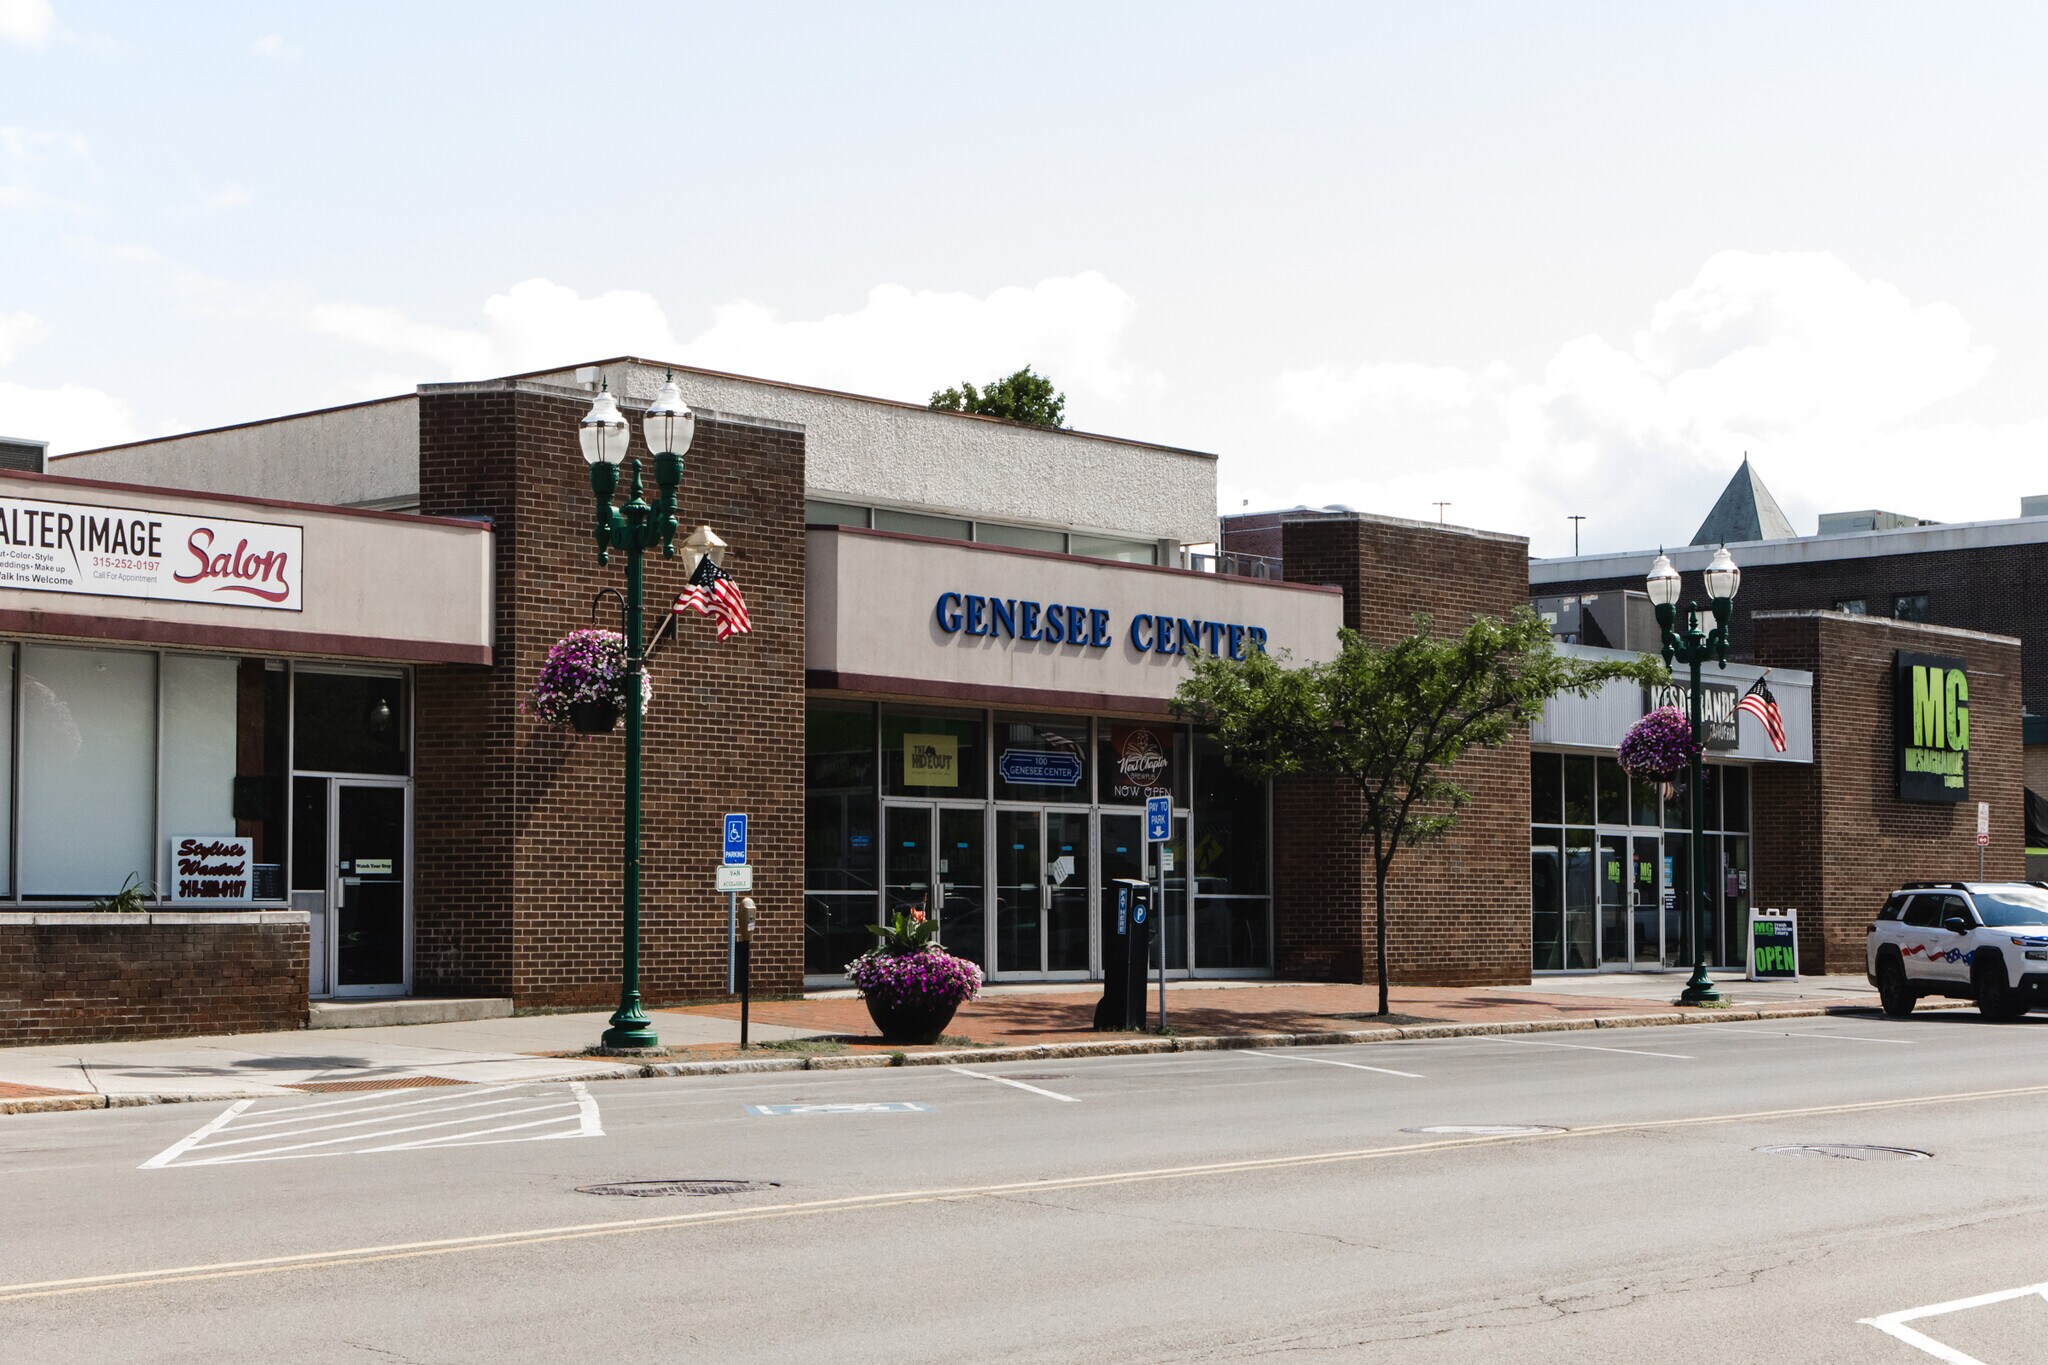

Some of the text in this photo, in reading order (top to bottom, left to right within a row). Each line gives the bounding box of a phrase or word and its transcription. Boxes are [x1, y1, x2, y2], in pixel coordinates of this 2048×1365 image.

[0, 507, 162, 558] ALTER IMAGE
[10, 550, 31, 559] Color
[35, 553, 54, 562] Style
[35, 563, 54, 572] Make
[56, 566, 66, 574] up
[93, 556, 160, 572] 315-252-0197
[173, 527, 290, 603] Salon
[0, 571, 74, 586] alk Ins Welcome
[93, 570, 158, 584] Call For Appointment
[936, 591, 1268, 662] GENESEE CENTER
[1912, 665, 1970, 752] MG
[1035, 757, 1048, 766] 100
[1117, 755, 1168, 774] Next Chapter
[1009, 765, 1073, 777] GENESEE CENTER
[1114, 785, 1172, 797] NOW OPEN
[1149, 801, 1168, 812] PAY TO
[1151, 815, 1166, 824] PARK
[177, 839, 246, 861] Stylists
[178, 858, 246, 876] Wanted
[1608, 861, 1620, 876] MG
[1640, 862, 1652, 876] MG
[1137, 907, 1144, 920] P
[1754, 922, 1774, 934] MG
[1755, 945, 1795, 972] OPEN
